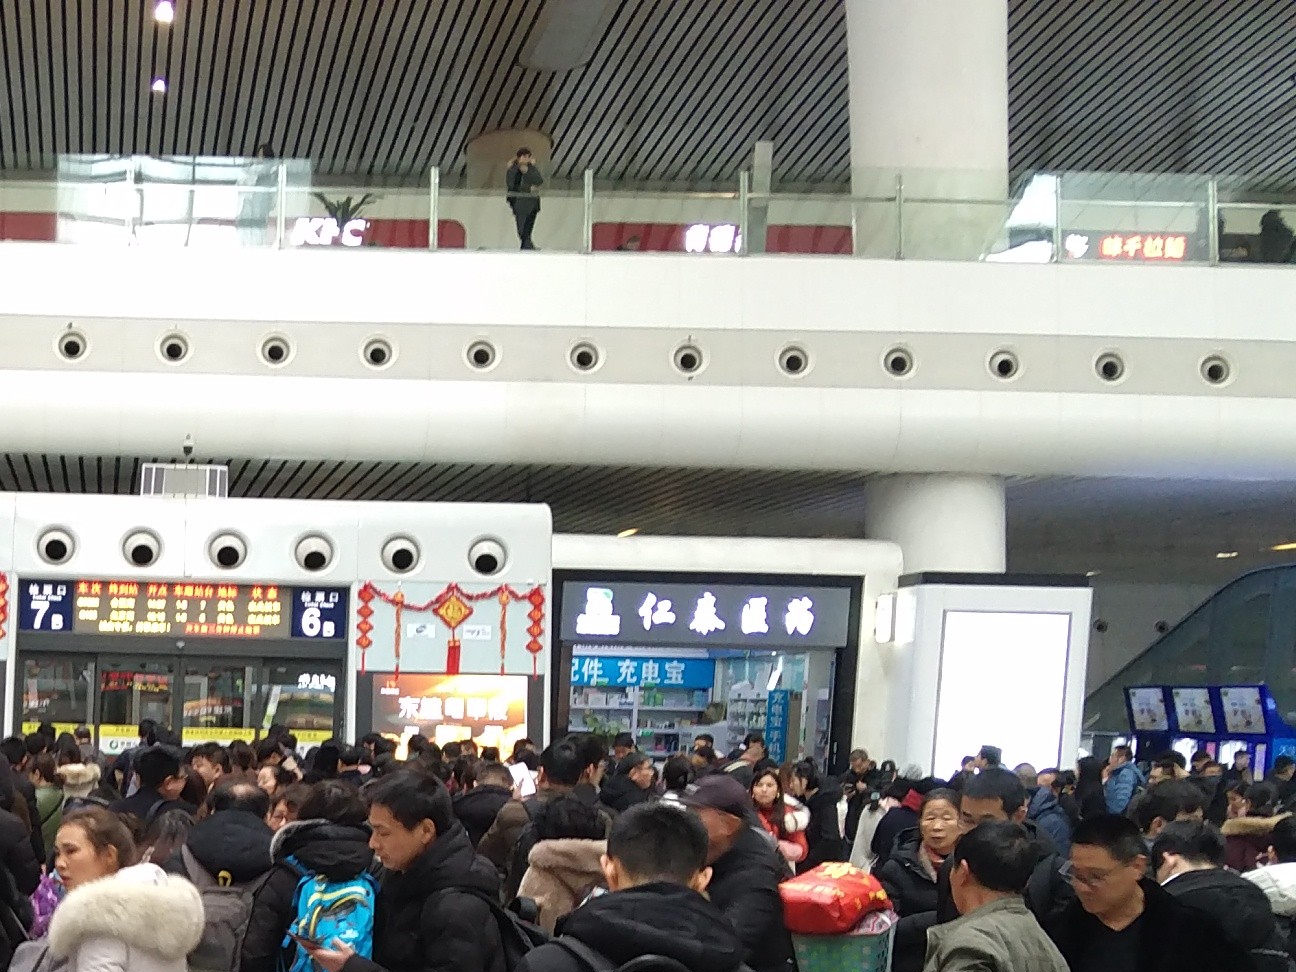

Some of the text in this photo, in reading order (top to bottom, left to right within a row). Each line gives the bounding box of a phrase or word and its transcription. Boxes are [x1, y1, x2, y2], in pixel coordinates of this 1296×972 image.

[290, 217, 366, 247] KFC
[616, 658, 686, 684] 充电宝
